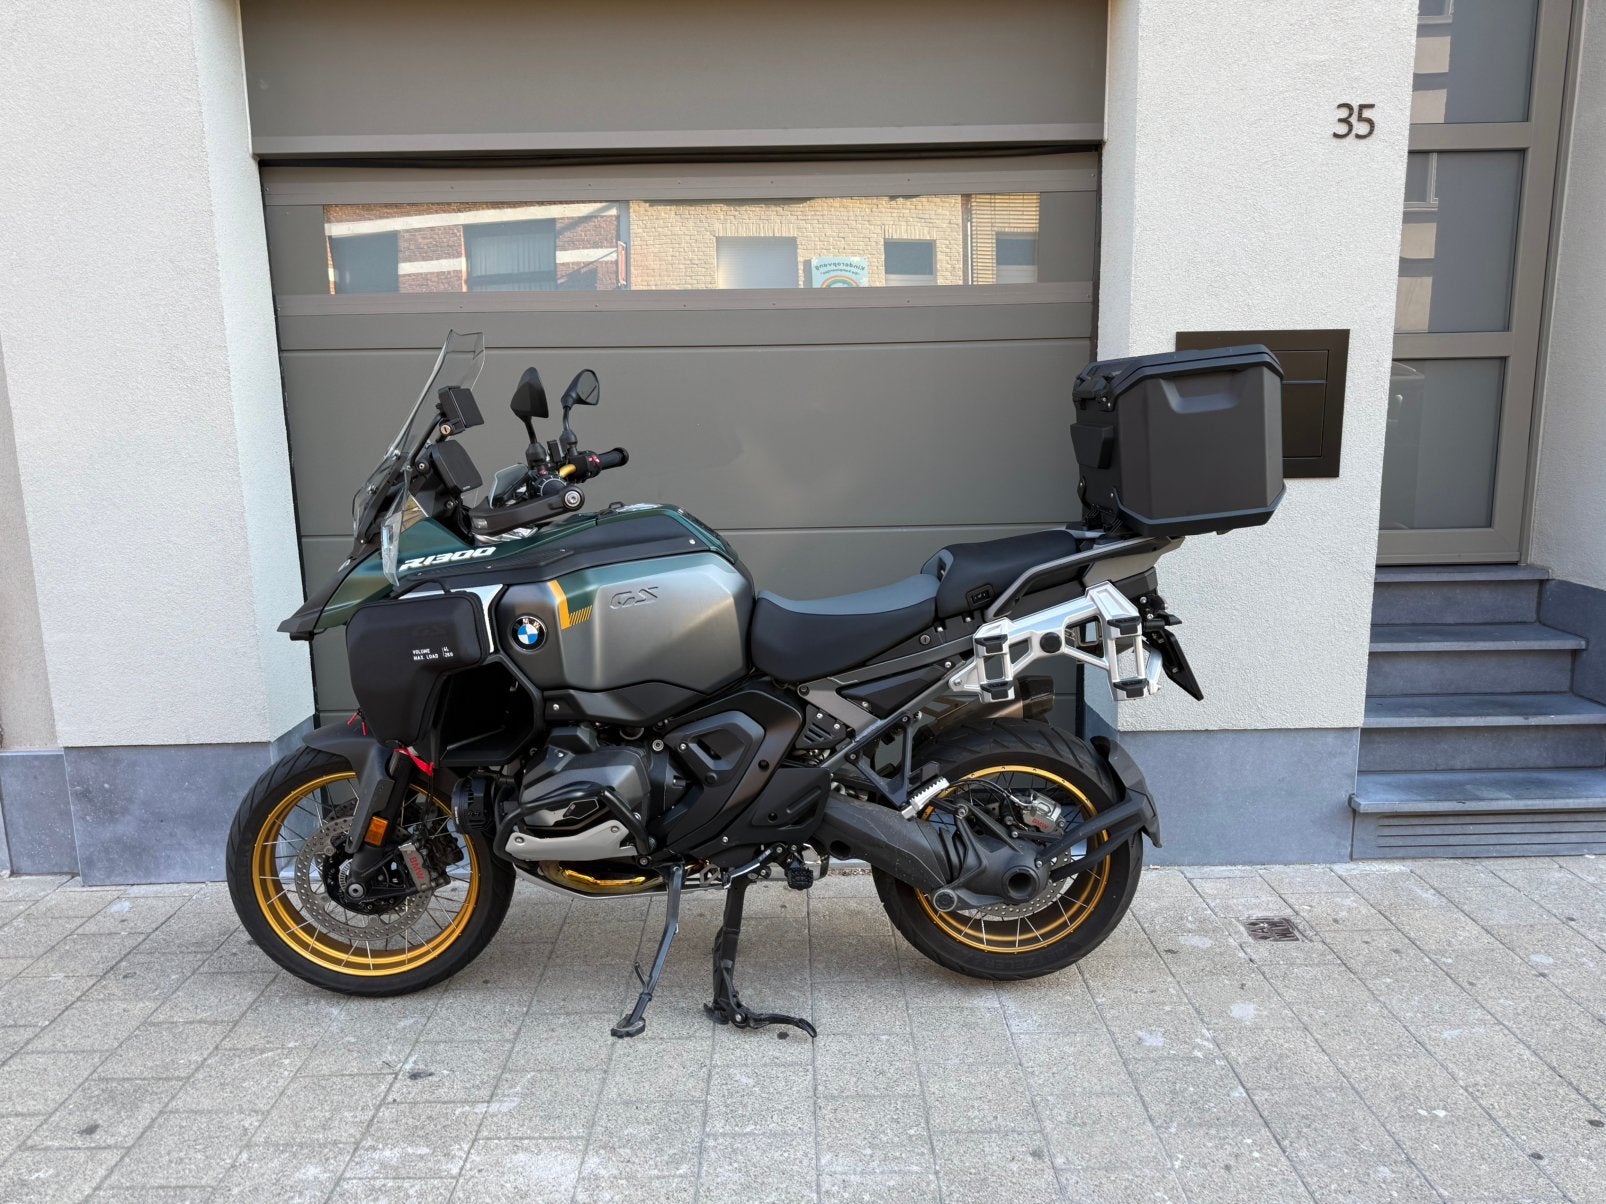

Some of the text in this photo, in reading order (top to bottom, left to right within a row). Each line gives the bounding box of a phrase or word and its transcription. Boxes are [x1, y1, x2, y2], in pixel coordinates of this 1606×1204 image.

[1332, 102, 1376, 139] 35
[399, 546, 497, 572] R1300
[610, 586, 659, 609] GS
[1032, 818, 1049, 830] BMW
[409, 856, 425, 880] BMW
